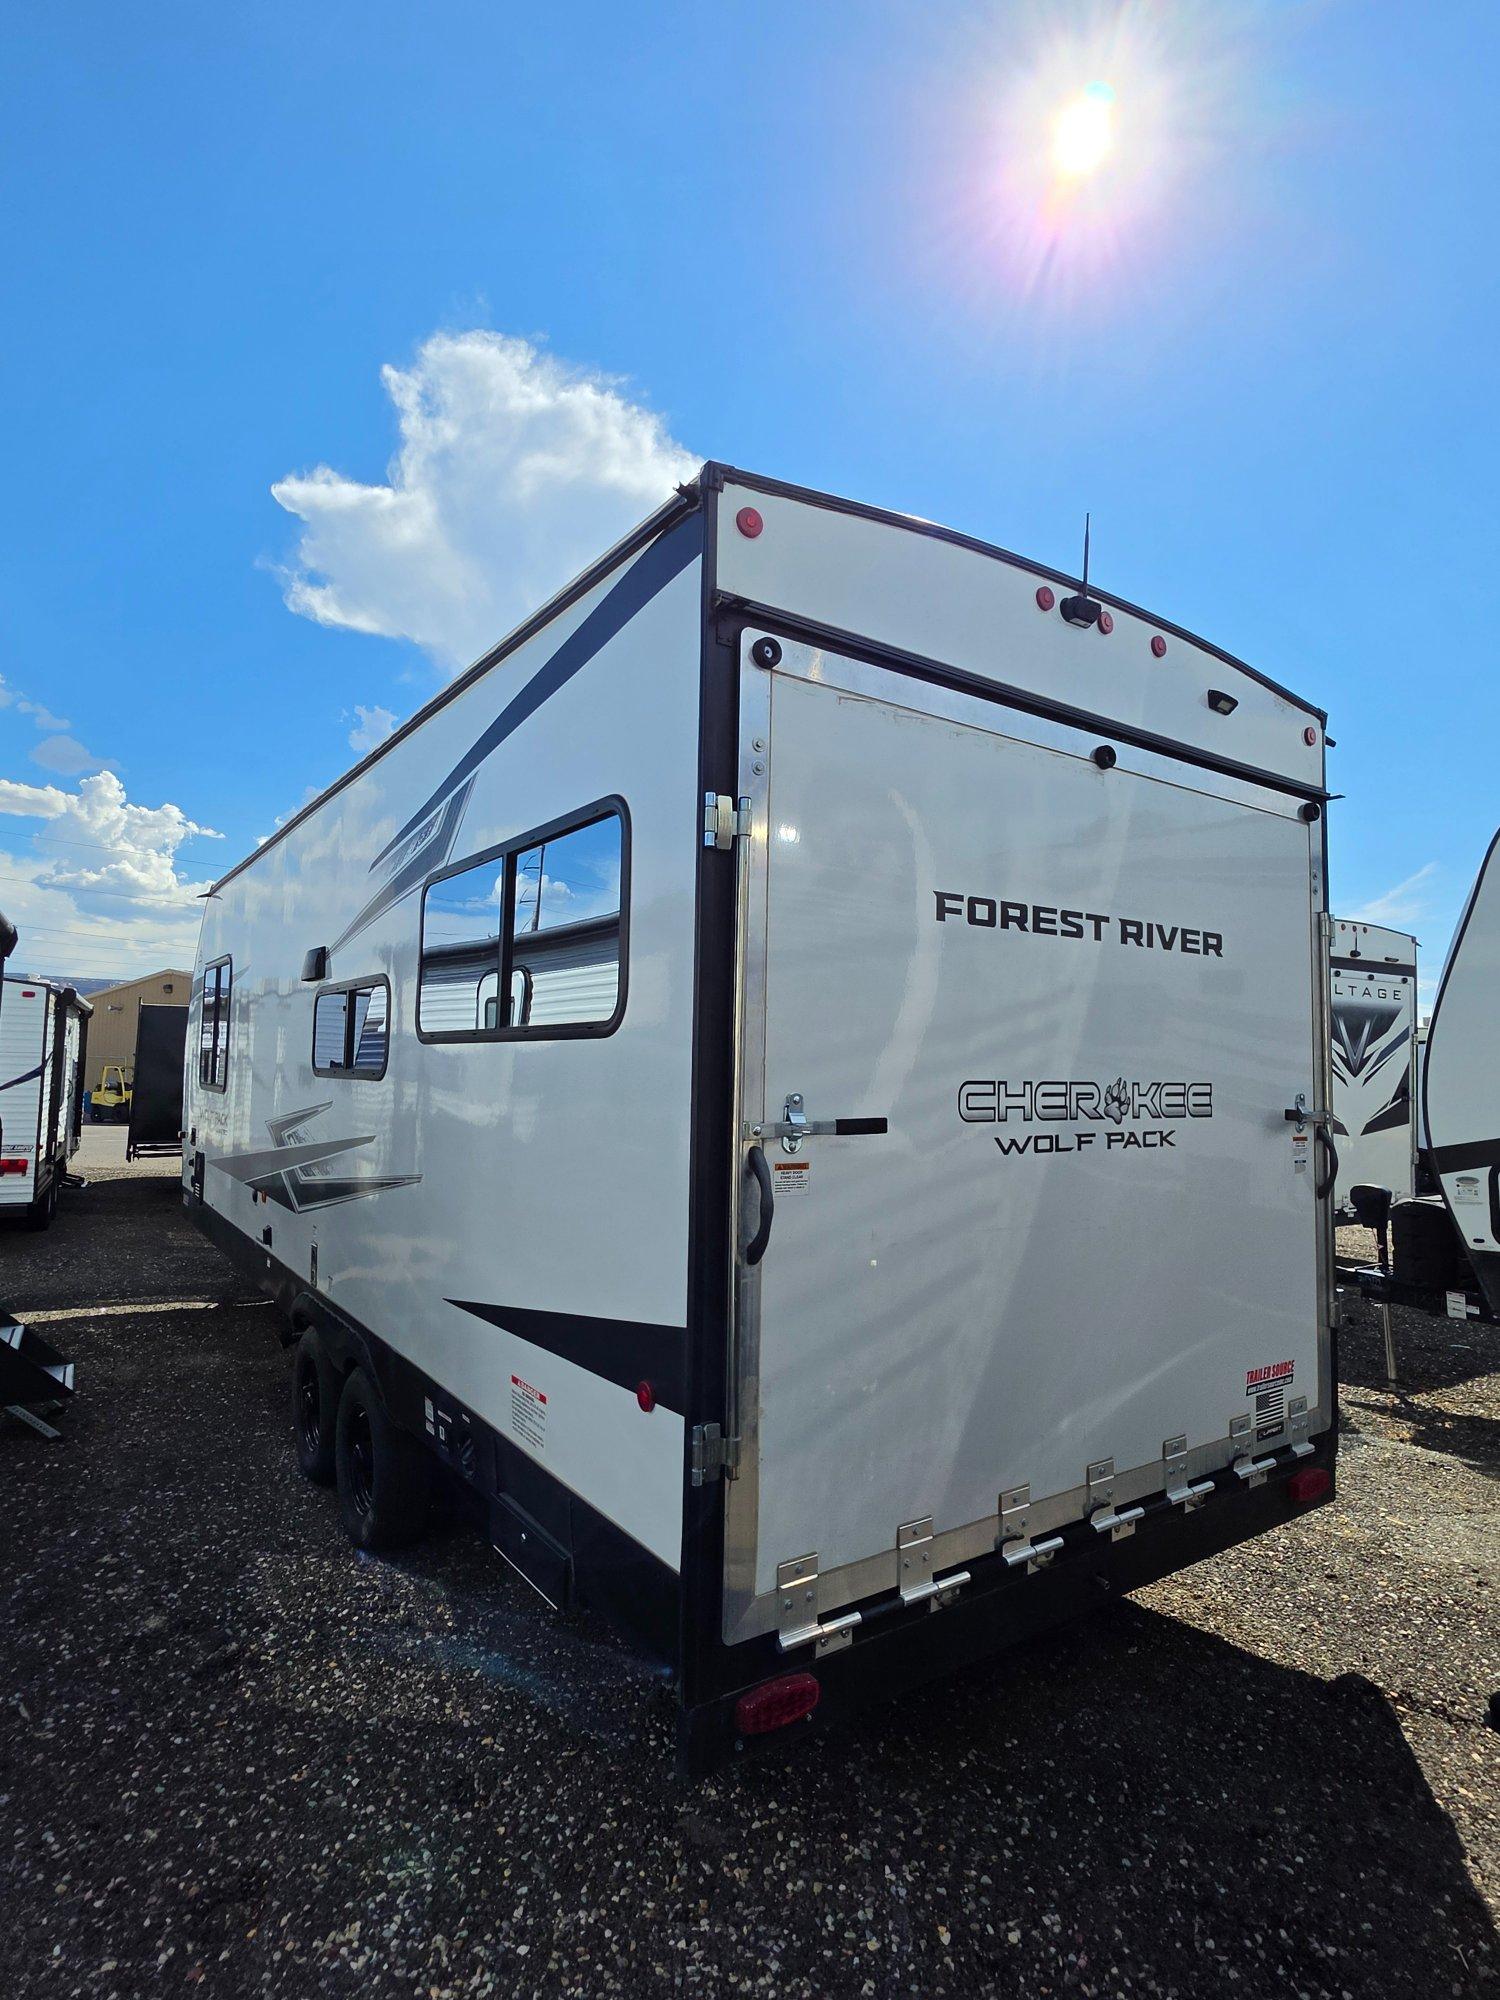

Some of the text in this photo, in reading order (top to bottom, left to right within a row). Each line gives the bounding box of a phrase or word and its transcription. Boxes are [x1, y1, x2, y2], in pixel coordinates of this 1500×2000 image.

[932, 889, 1224, 958] FOREST RIVER
[1334, 983, 1402, 1001] LTAGE
[957, 1078, 1213, 1124] CHEROKEE
[994, 1129, 1176, 1156] WOLF PACK
[1246, 1359, 1295, 1385] TRAILER SOURCE
